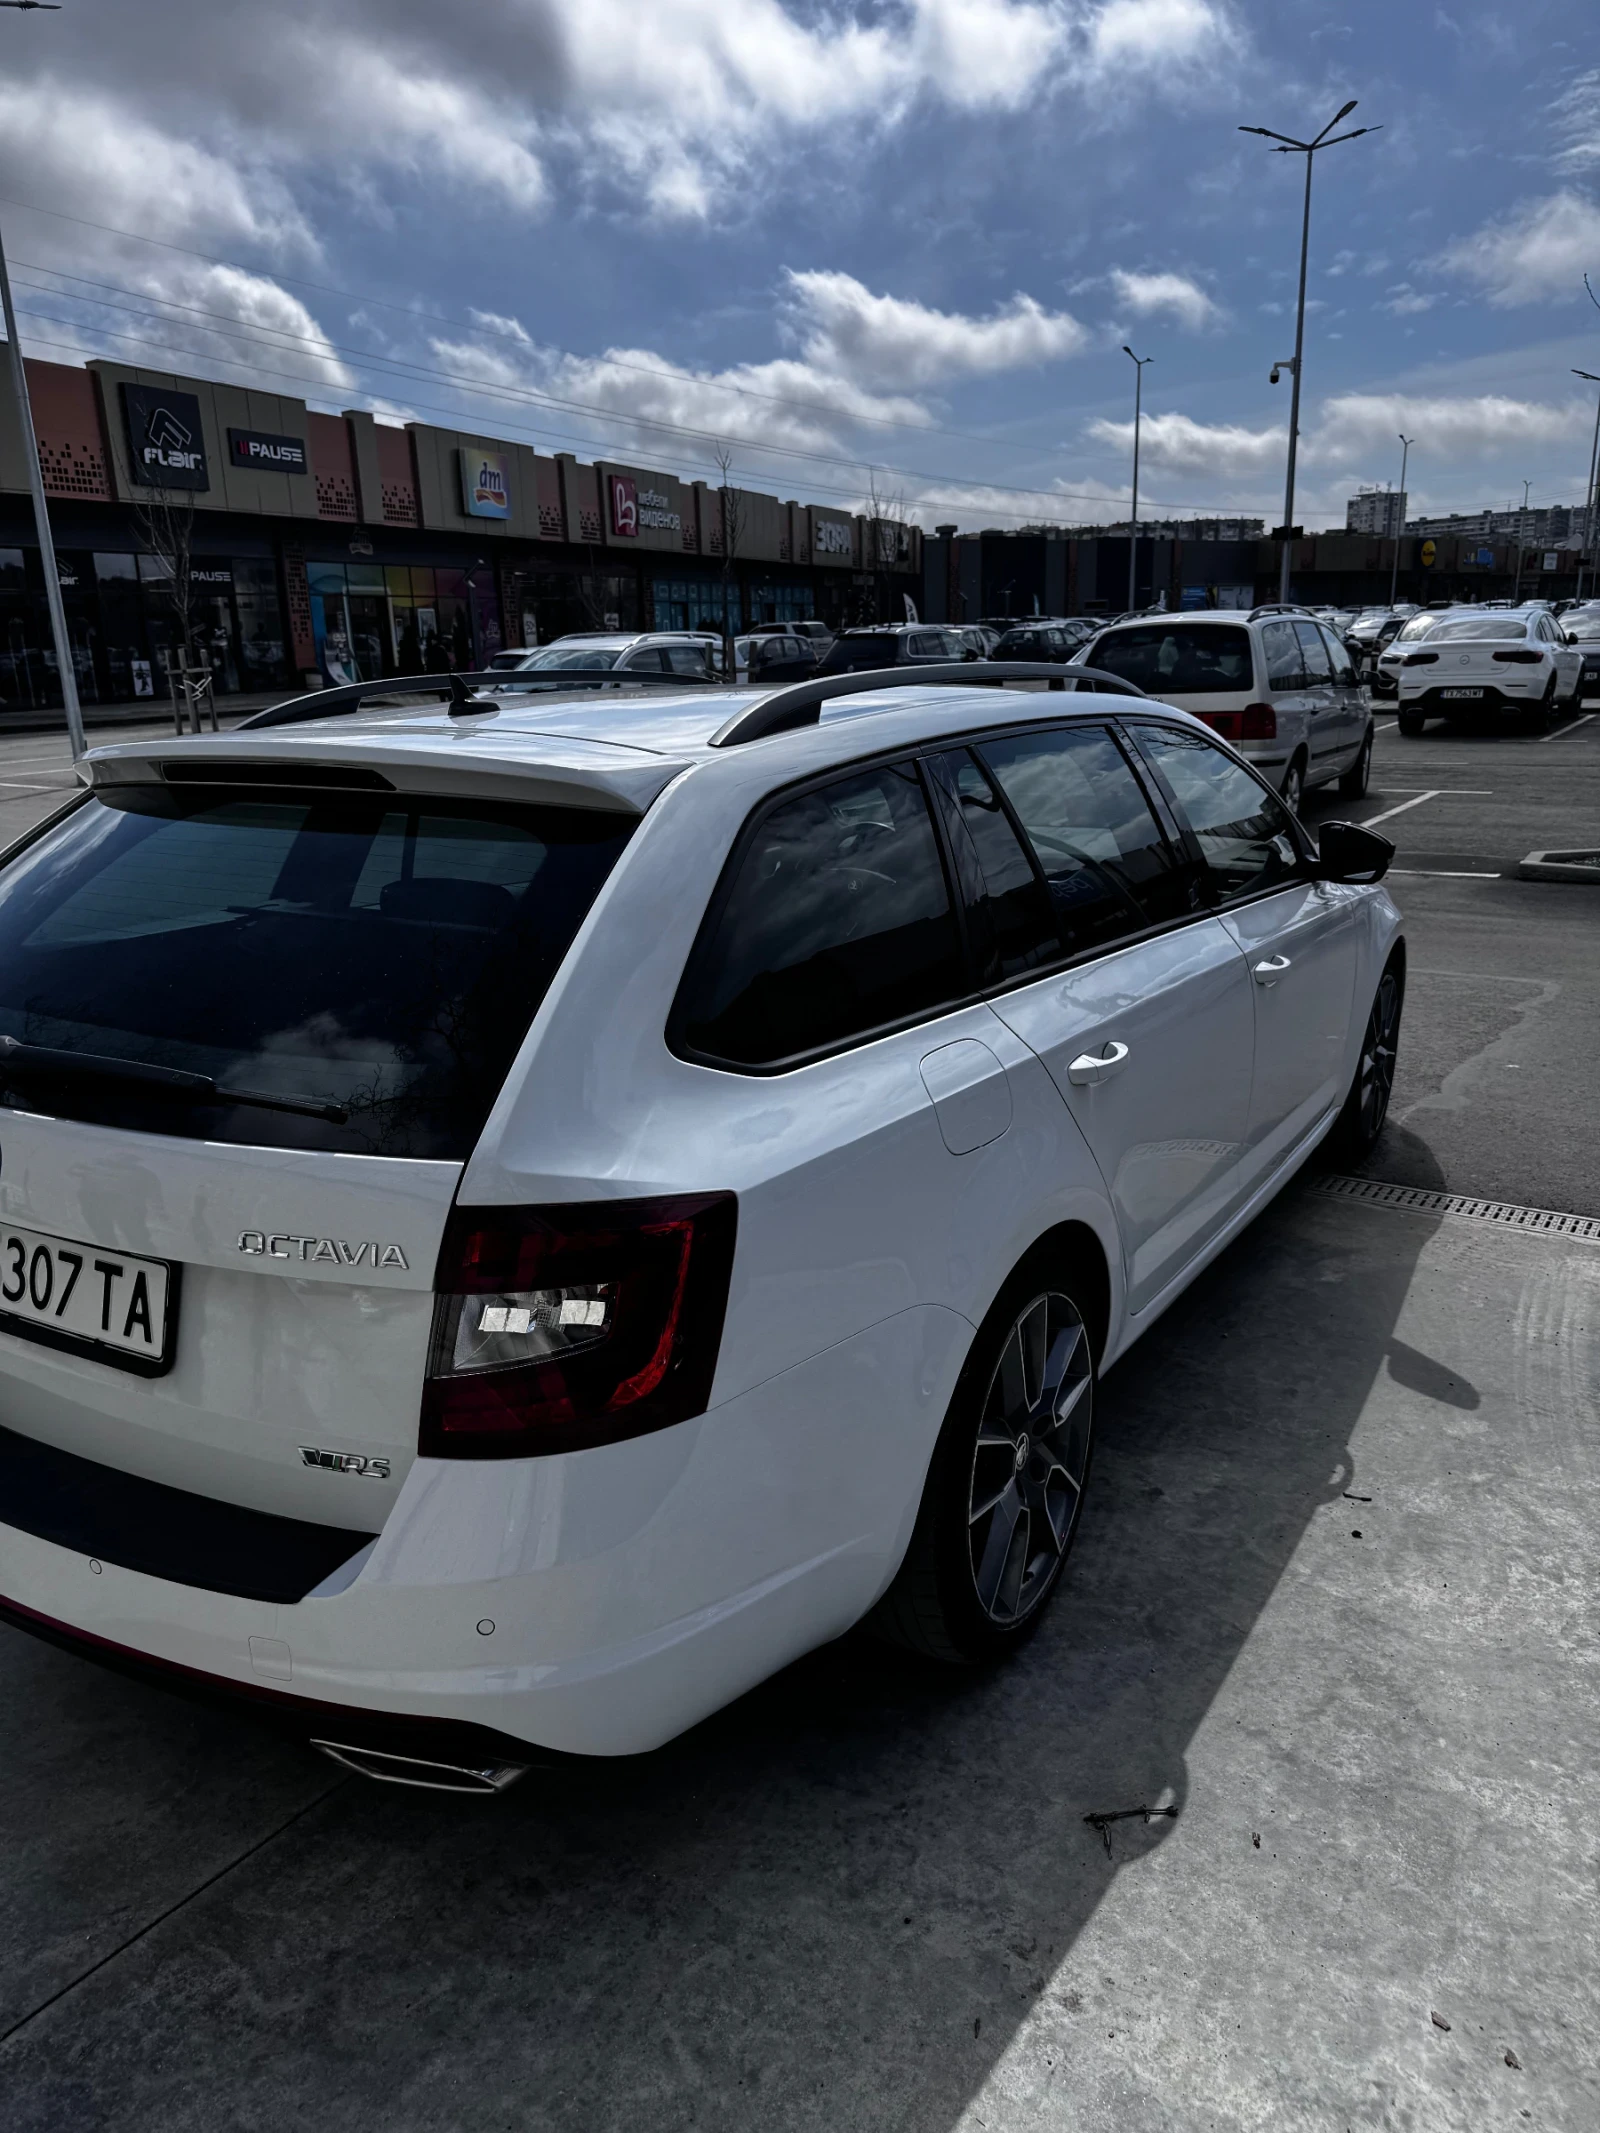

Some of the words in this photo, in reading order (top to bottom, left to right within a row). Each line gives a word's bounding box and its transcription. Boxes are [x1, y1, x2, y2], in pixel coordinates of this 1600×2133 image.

[248, 441, 303, 462] PAUSE
[479, 461, 501, 490] dm
[190, 570, 232, 582] PAUSE
[237, 1230, 410, 1270] OCTAVIA
[0, 1235, 84, 1317] 307
[94, 1259, 153, 1344] TA
